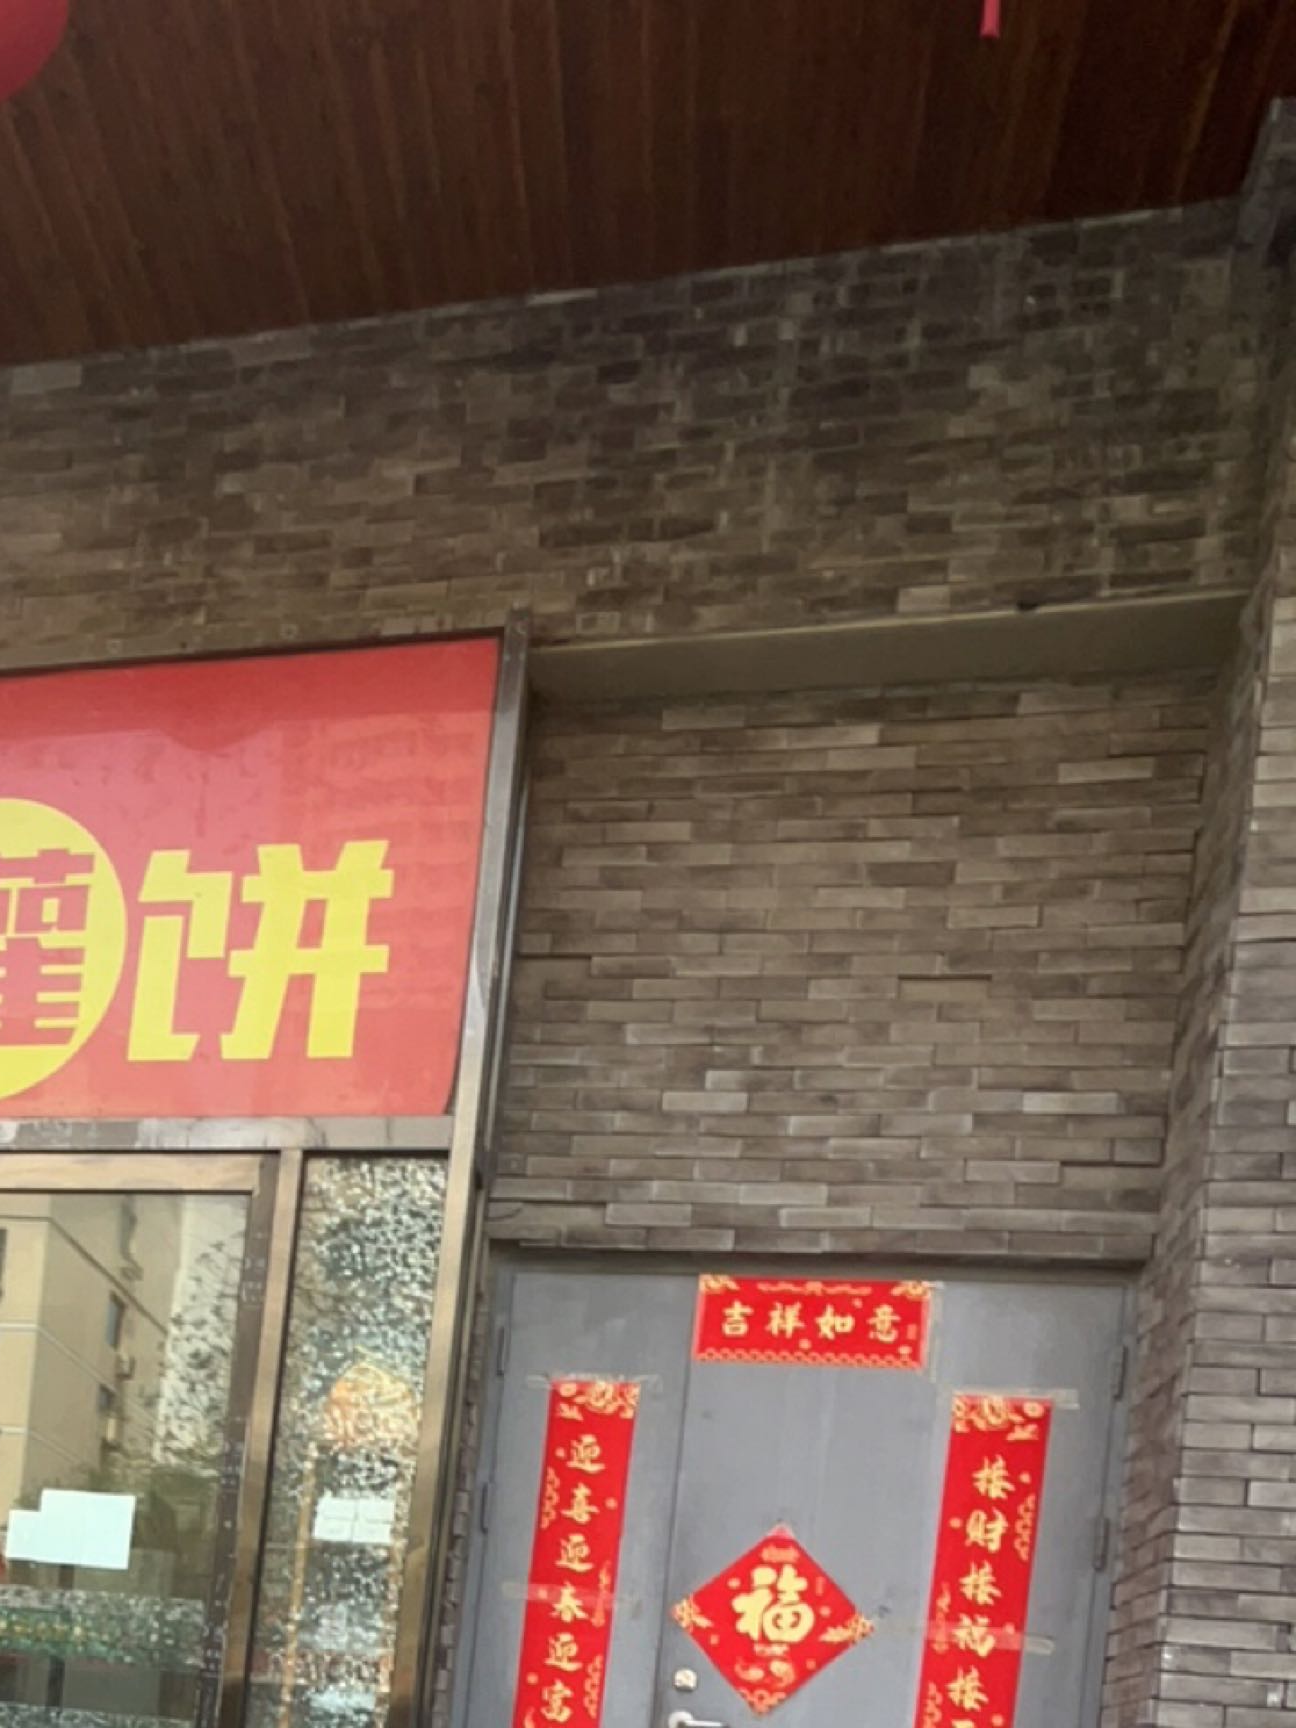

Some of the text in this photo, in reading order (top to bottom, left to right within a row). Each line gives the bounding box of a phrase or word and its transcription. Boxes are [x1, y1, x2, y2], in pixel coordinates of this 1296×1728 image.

[722, 1300, 901, 1342] 吉祥如意
[731, 1563, 815, 1643] 福
